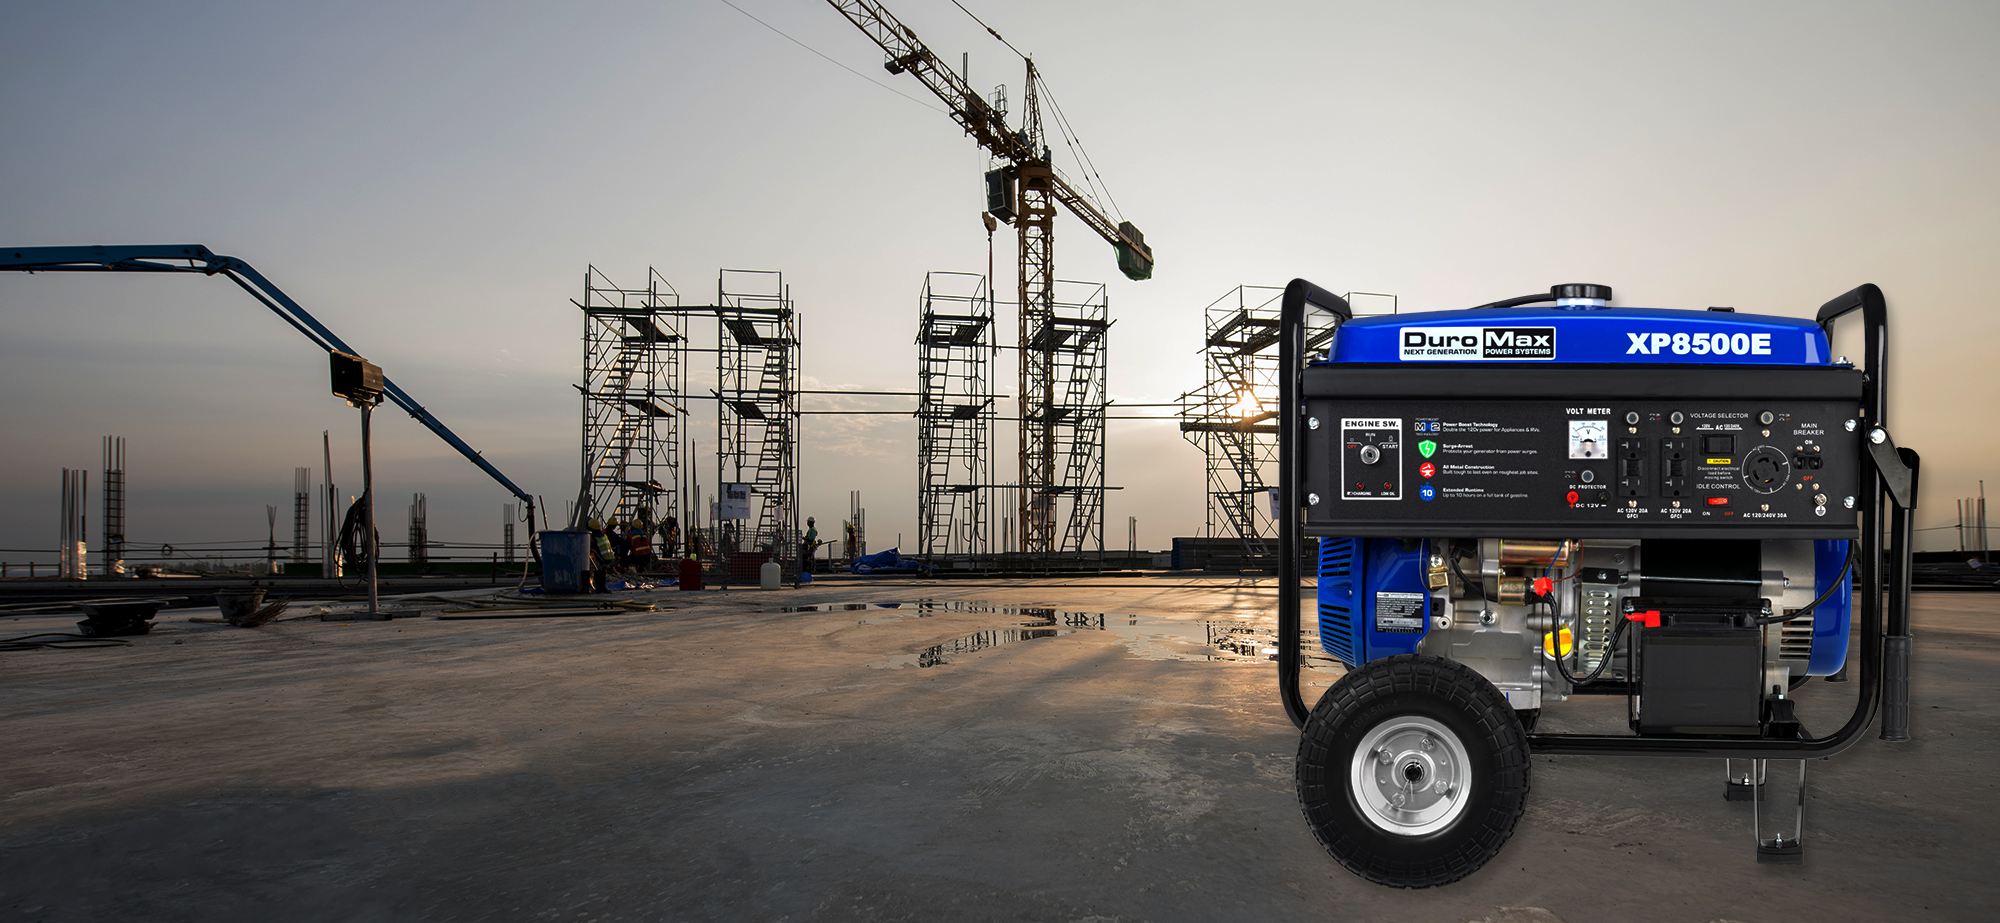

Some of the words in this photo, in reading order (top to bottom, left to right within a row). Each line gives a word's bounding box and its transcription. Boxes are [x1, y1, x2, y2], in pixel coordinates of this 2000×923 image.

[1404, 331, 1477, 348] Duro
[1485, 331, 1550, 348] Max
[1626, 333, 1772, 355] XP8500E
